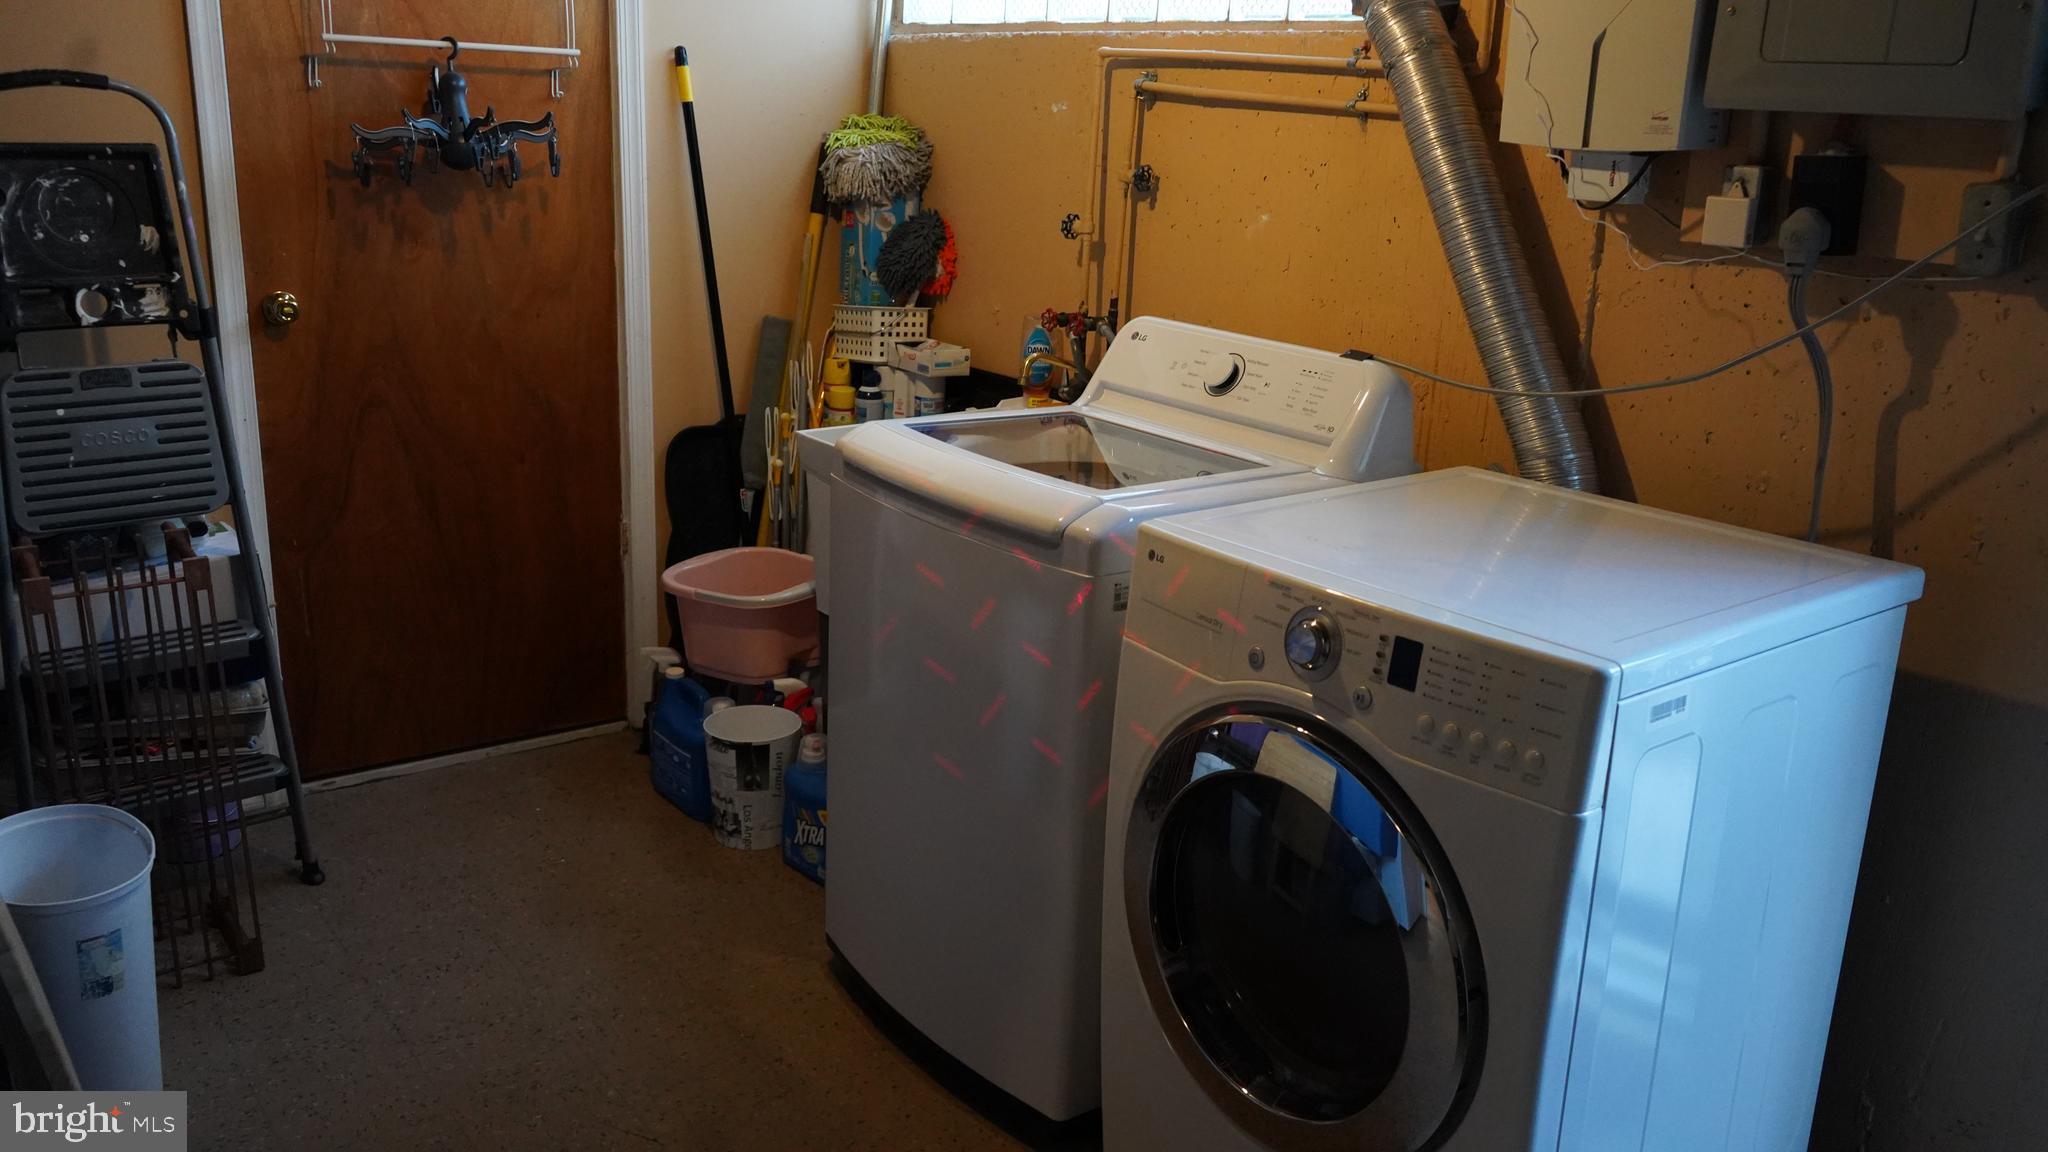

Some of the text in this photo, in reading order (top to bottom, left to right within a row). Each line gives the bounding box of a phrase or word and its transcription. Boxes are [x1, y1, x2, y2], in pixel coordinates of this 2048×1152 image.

[81, 429, 149, 447] COSCO
[1156, 553, 1165, 564] LG
[773, 752, 783, 798] London
[743, 805, 752, 823] Los
[794, 818, 825, 847] XTRA
